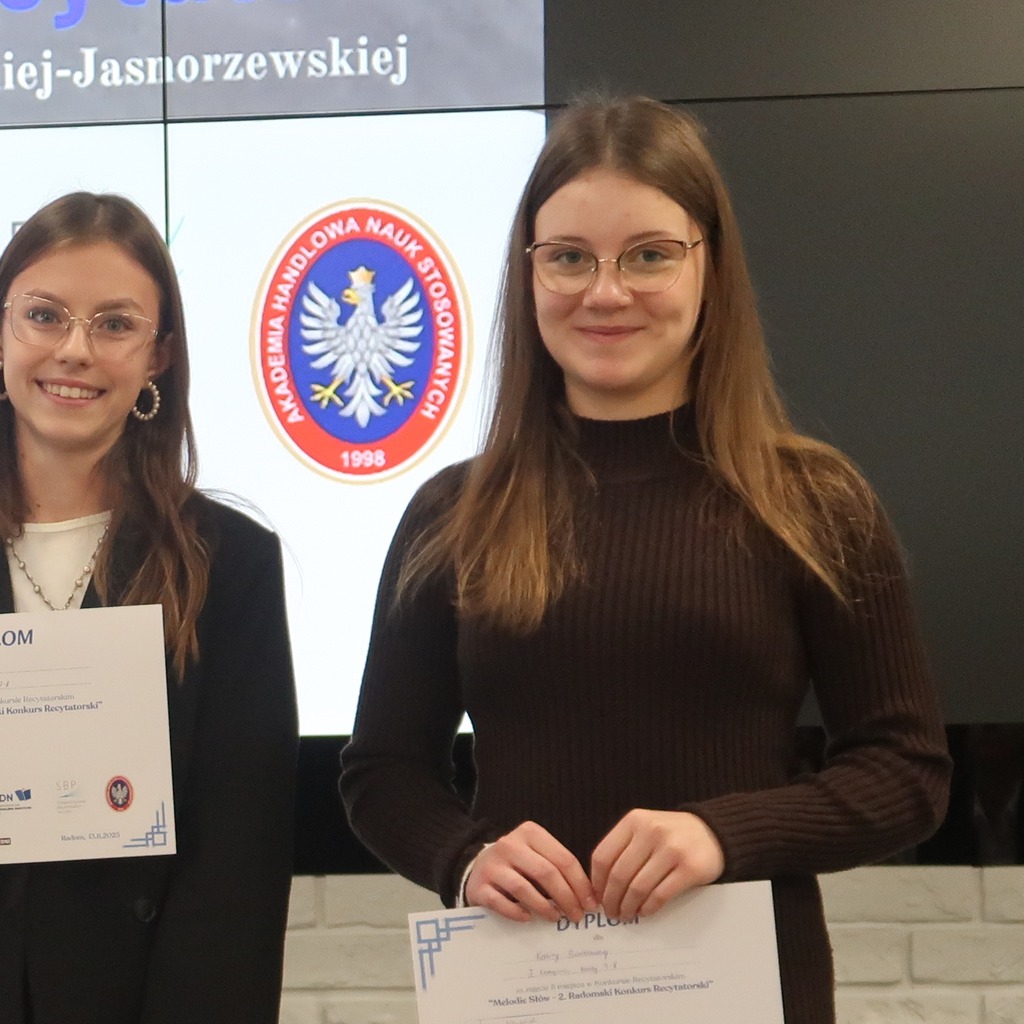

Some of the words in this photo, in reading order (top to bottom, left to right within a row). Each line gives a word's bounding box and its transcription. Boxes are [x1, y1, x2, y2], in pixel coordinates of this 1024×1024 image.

[365, 215, 424, 258] NAUK
[272, 216, 362, 313] HANDLOWA
[416, 256, 456, 420] STOSOWANYCH
[266, 317, 305, 424] AKADEMIA
[340, 449, 386, 467] 1998
[6, 705, 42, 715] Konkurs
[56, 780, 77, 790] SBP
[568, 989, 613, 1000] Radomski
[614, 986, 651, 996] Konkurs
